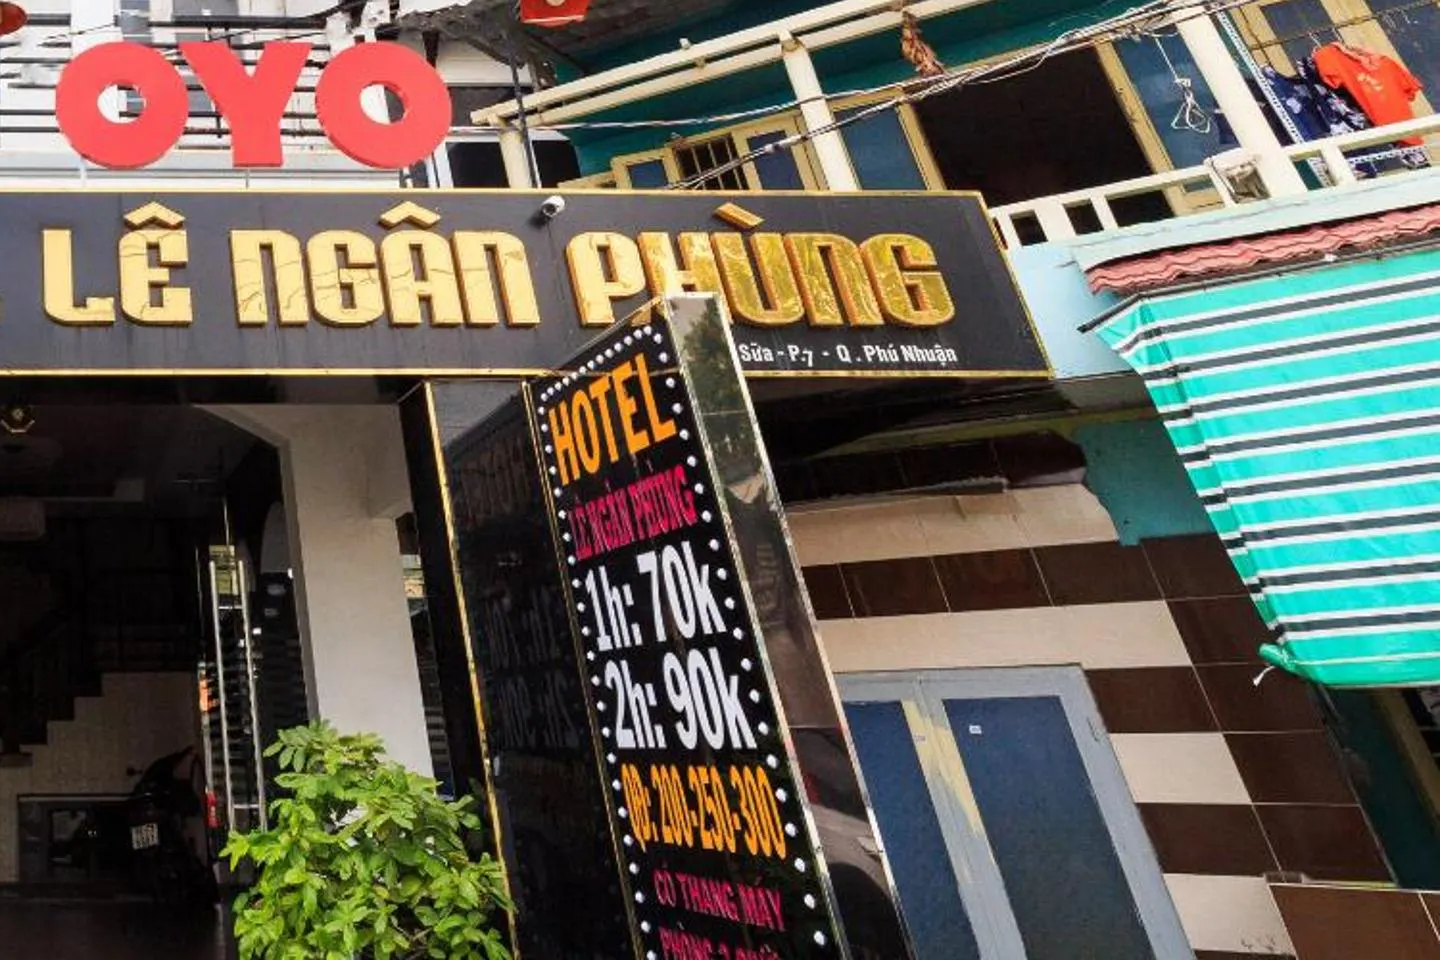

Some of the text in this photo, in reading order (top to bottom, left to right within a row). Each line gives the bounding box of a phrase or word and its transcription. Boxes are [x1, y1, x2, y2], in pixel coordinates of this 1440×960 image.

[55, 41, 453, 170] OYO
[42, 201, 192, 326] LÊ
[229, 201, 540, 327] NGÂN
[565, 201, 956, 328] PHÙNG
[862, 343, 899, 363] Phú
[548, 353, 677, 486] HOTEL
[585, 566, 643, 651] 1h:
[604, 659, 667, 749] 2h:
[650, 762, 787, 860] 200-250-300
